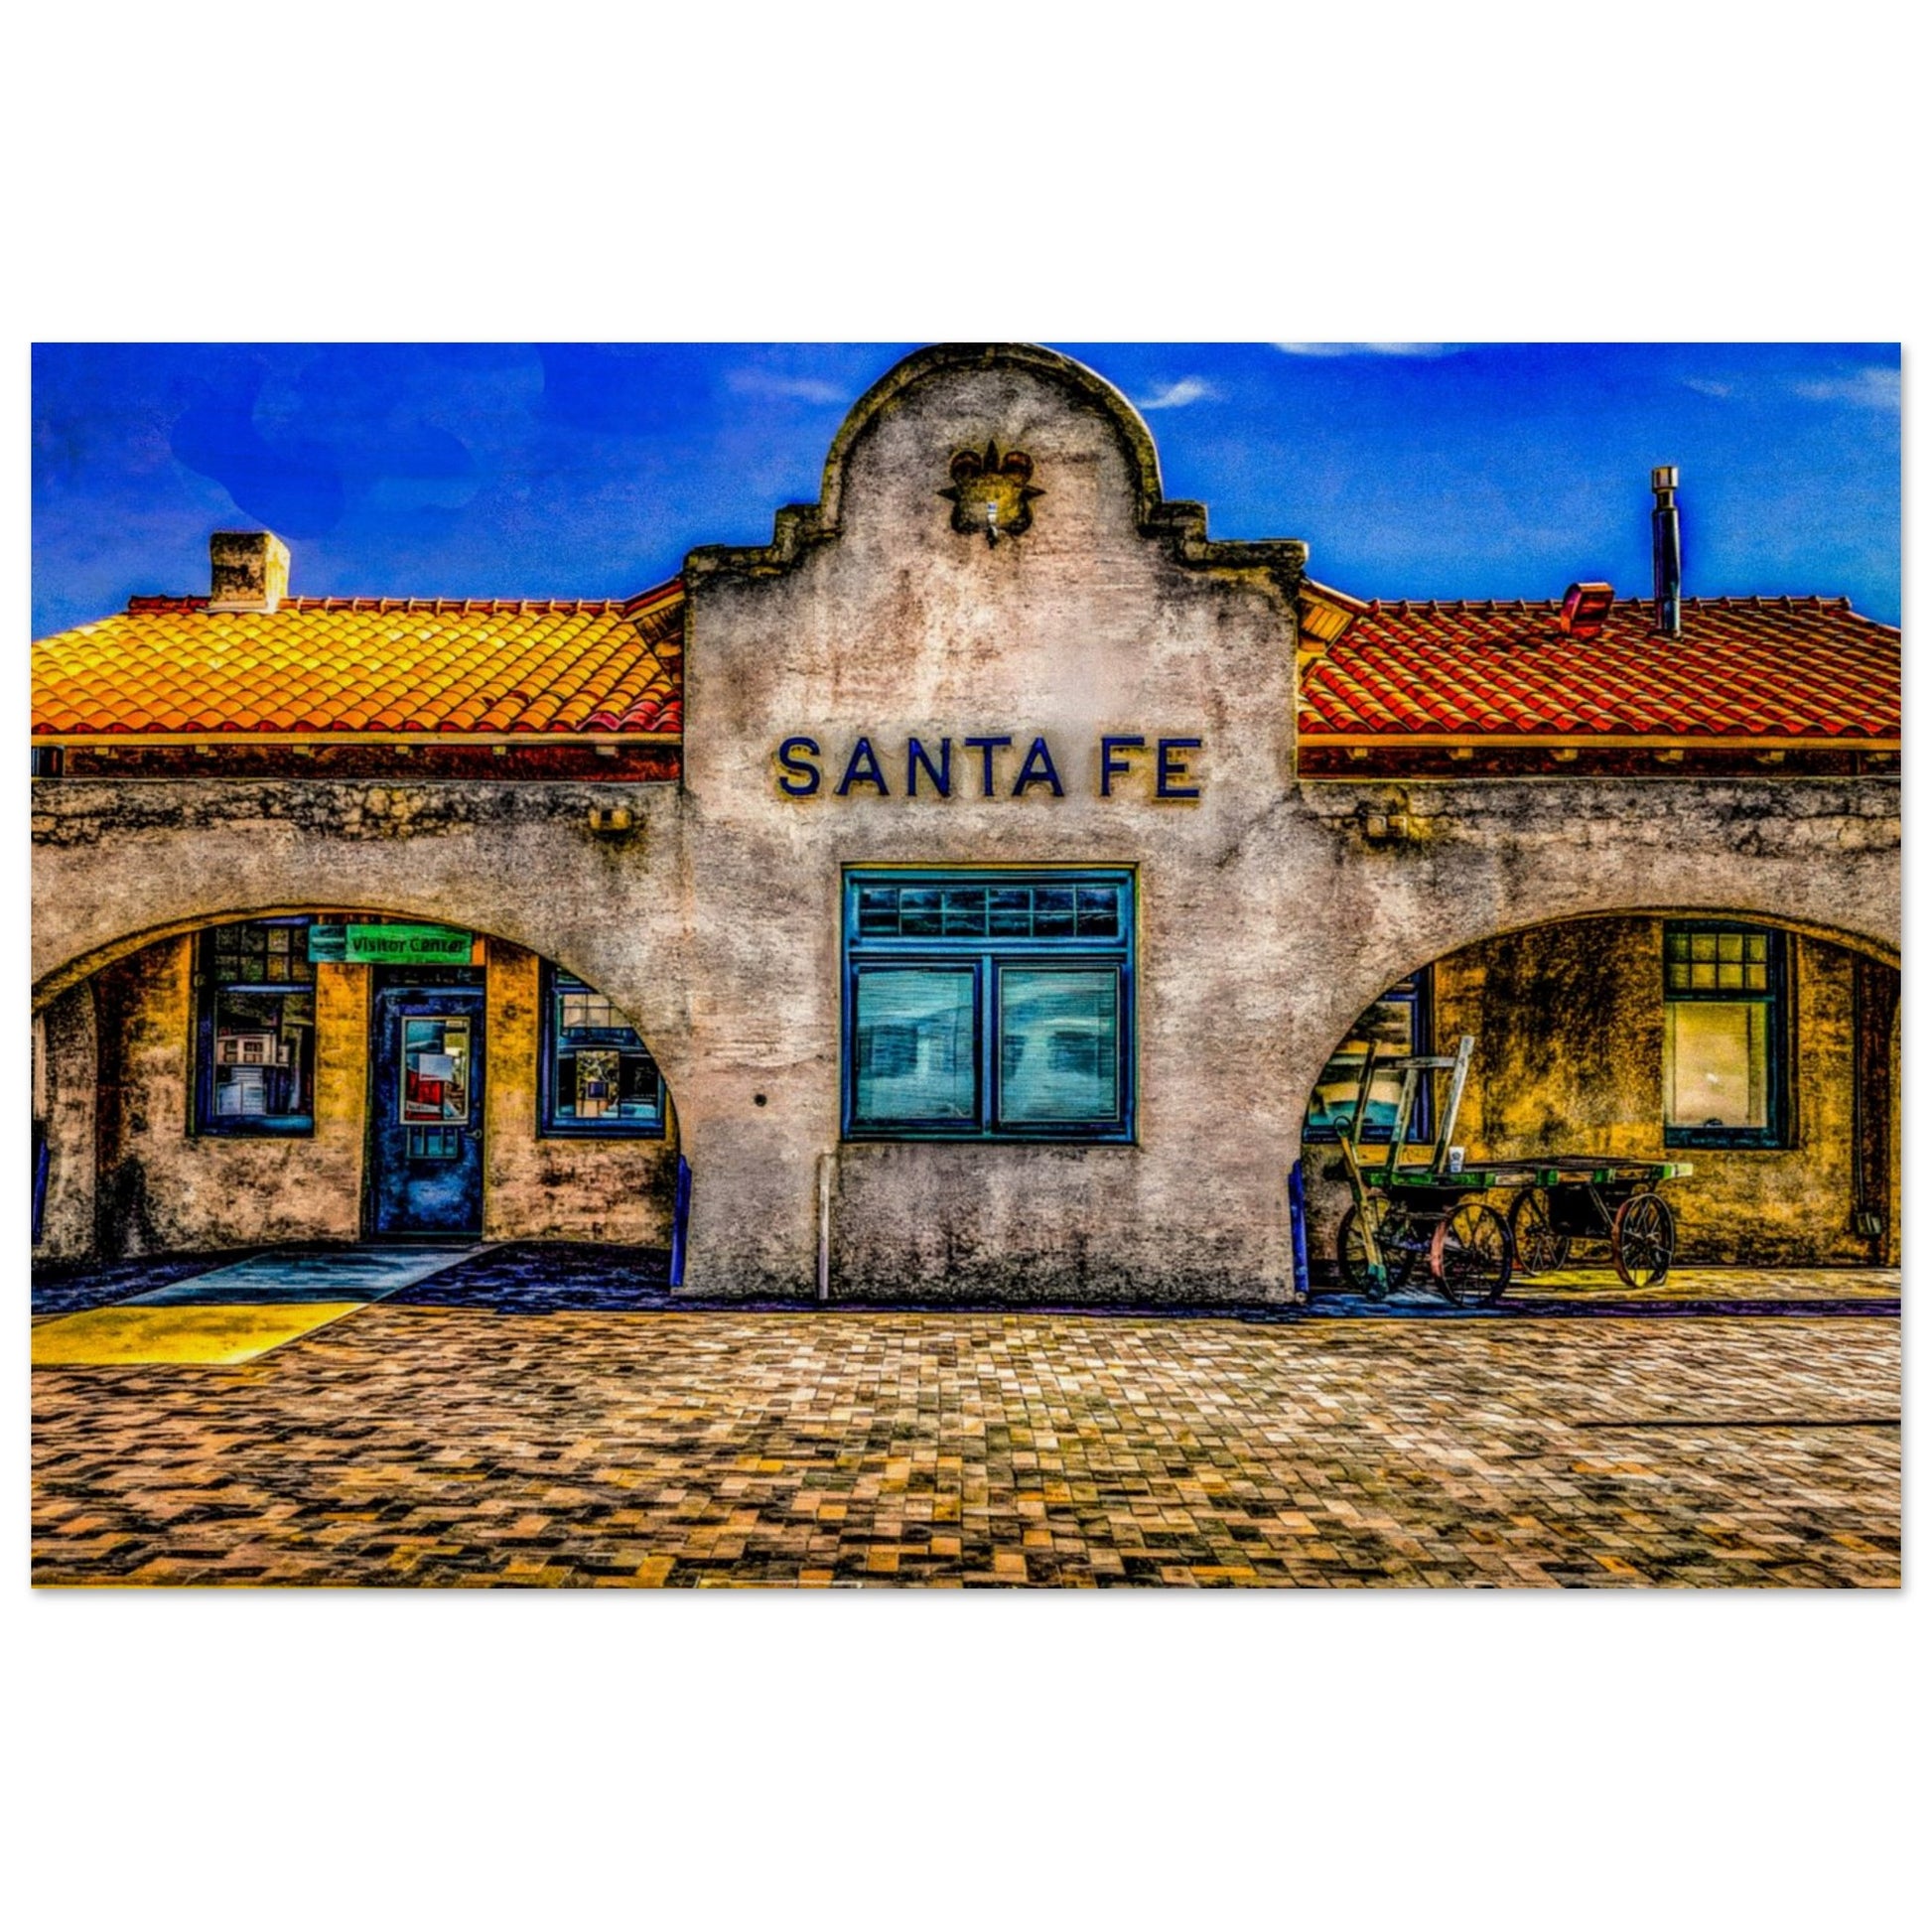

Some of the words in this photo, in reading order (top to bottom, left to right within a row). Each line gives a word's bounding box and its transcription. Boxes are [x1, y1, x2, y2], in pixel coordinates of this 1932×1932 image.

[777, 736, 1065, 798] SANTA
[1100, 736, 1202, 798] FE
[352, 937, 406, 953] Visitor
[410, 938, 465, 953] Center
